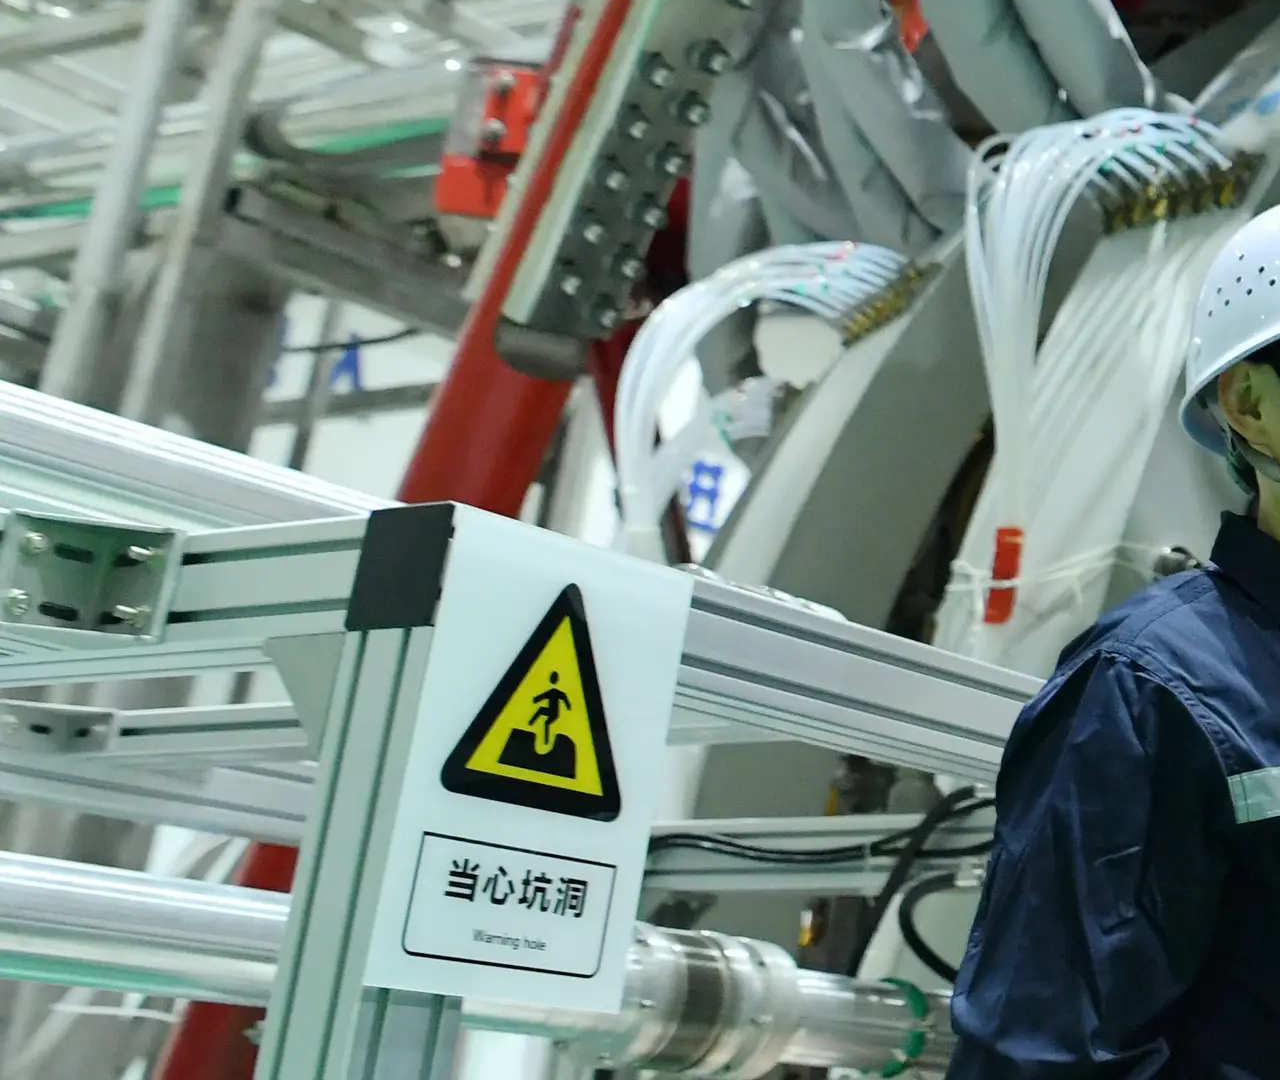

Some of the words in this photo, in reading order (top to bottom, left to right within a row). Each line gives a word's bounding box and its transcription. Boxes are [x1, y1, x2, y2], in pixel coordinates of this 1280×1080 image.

[444, 858, 588, 918] 当心坑洞
[472, 927, 520, 951] Warning
[522, 933, 547, 952] hole
